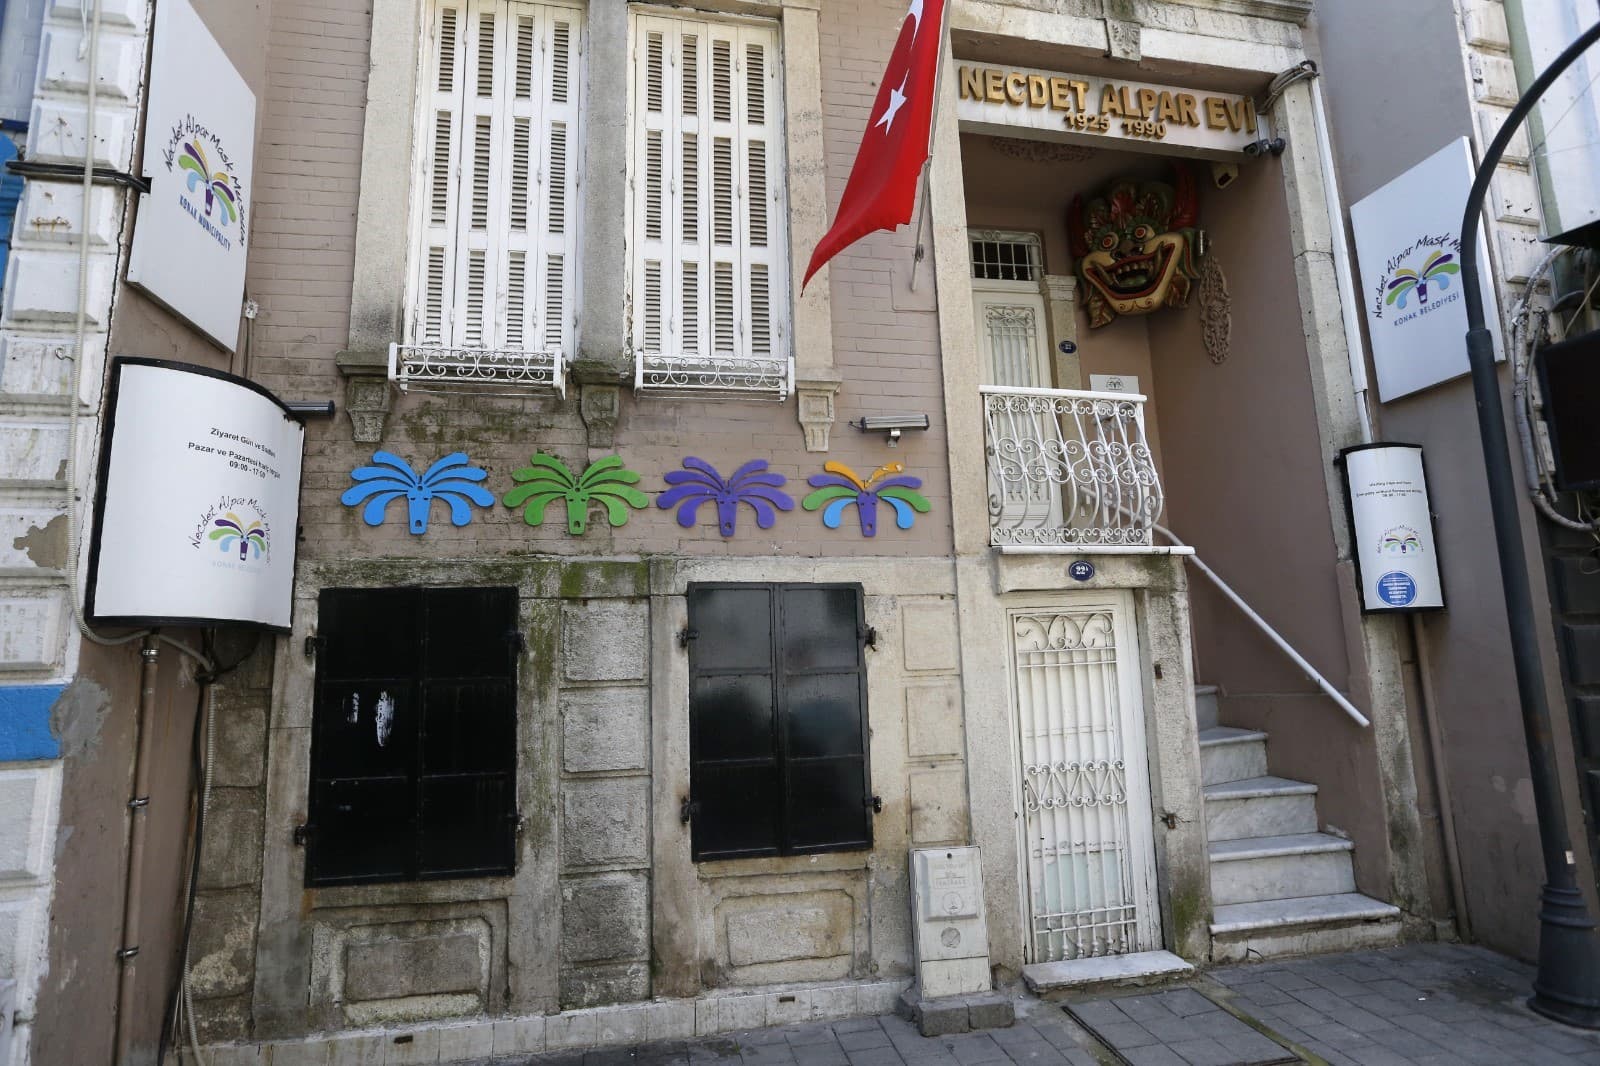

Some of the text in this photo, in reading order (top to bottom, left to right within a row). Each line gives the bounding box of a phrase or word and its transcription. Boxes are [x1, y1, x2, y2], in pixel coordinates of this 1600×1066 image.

[958, 65, 1089, 111] NECDET
[1101, 83, 1200, 127] ALPAR
[162, 119, 185, 173] Necdet
[185, 113, 209, 139] Alpar
[210, 134, 234, 172] Mask
[1064, 111, 1167, 140] 1925 1990
[179, 194, 231, 251] KONAK MUNICIPALITY
[1371, 232, 1450, 319] Necdet Alpar Mask
[1394, 311, 1418, 327] KONAK
[188, 442, 215, 454] Pazar
[217, 448, 227, 456] ve
[210, 427, 240, 441] Ziyaret
[188, 504, 218, 549] Necdet
